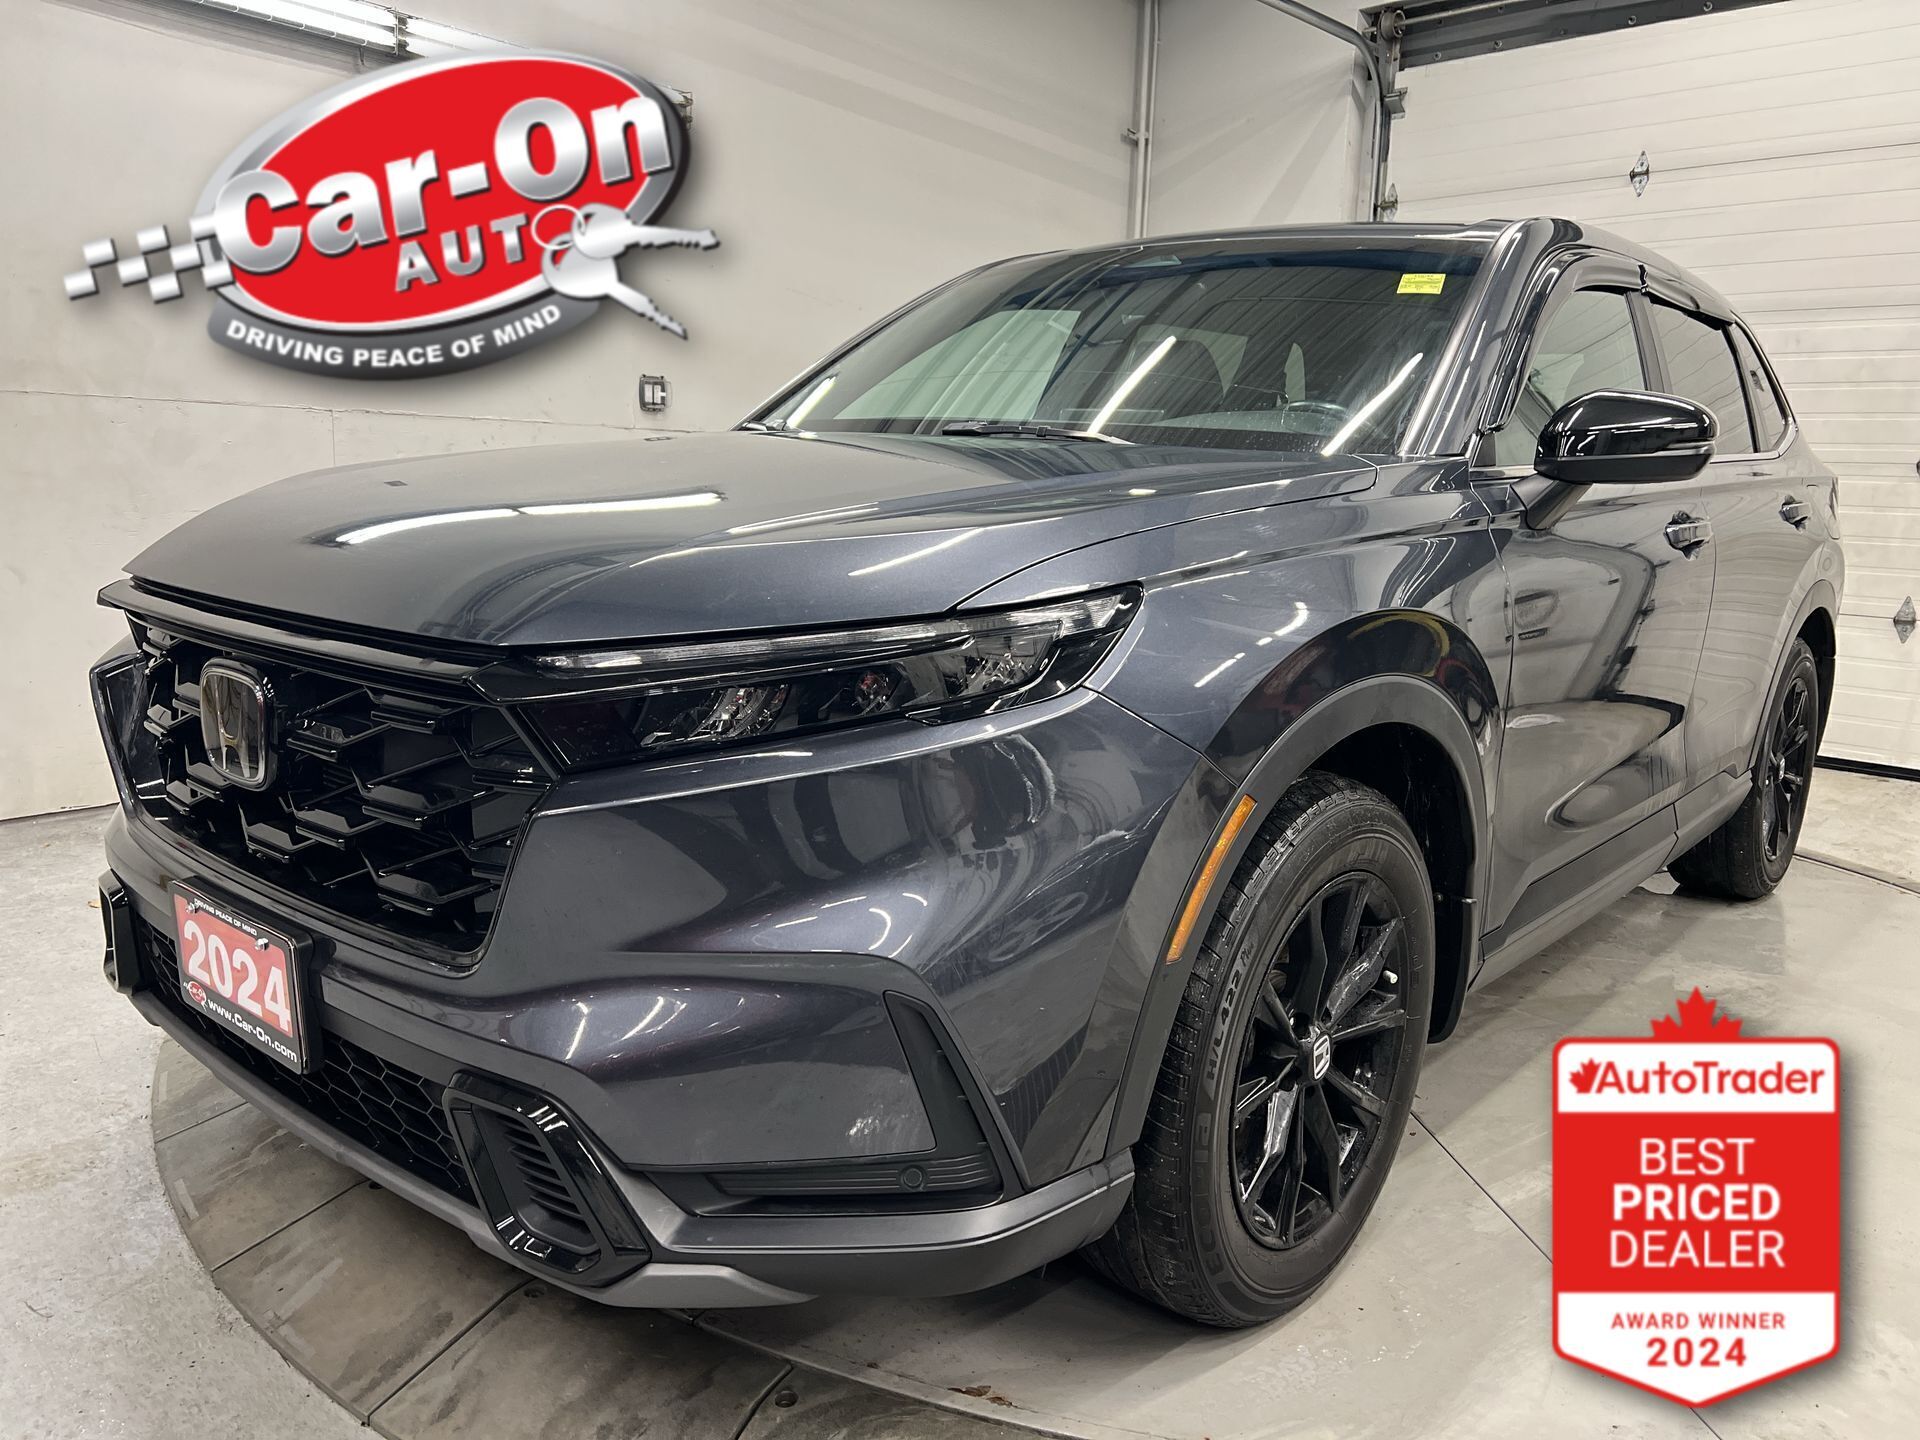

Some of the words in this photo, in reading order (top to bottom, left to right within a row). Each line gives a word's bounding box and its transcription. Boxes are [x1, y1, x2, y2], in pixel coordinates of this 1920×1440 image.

[194, 898, 215, 914] DRIVING
[215, 909, 233, 924] PEACE
[233, 918, 241, 928] OF
[241, 923, 257, 936] MIND
[183, 919, 291, 1032] 2024
[1221, 969, 1242, 1026] 422
[207, 999, 298, 1063] www.Car-On.com
